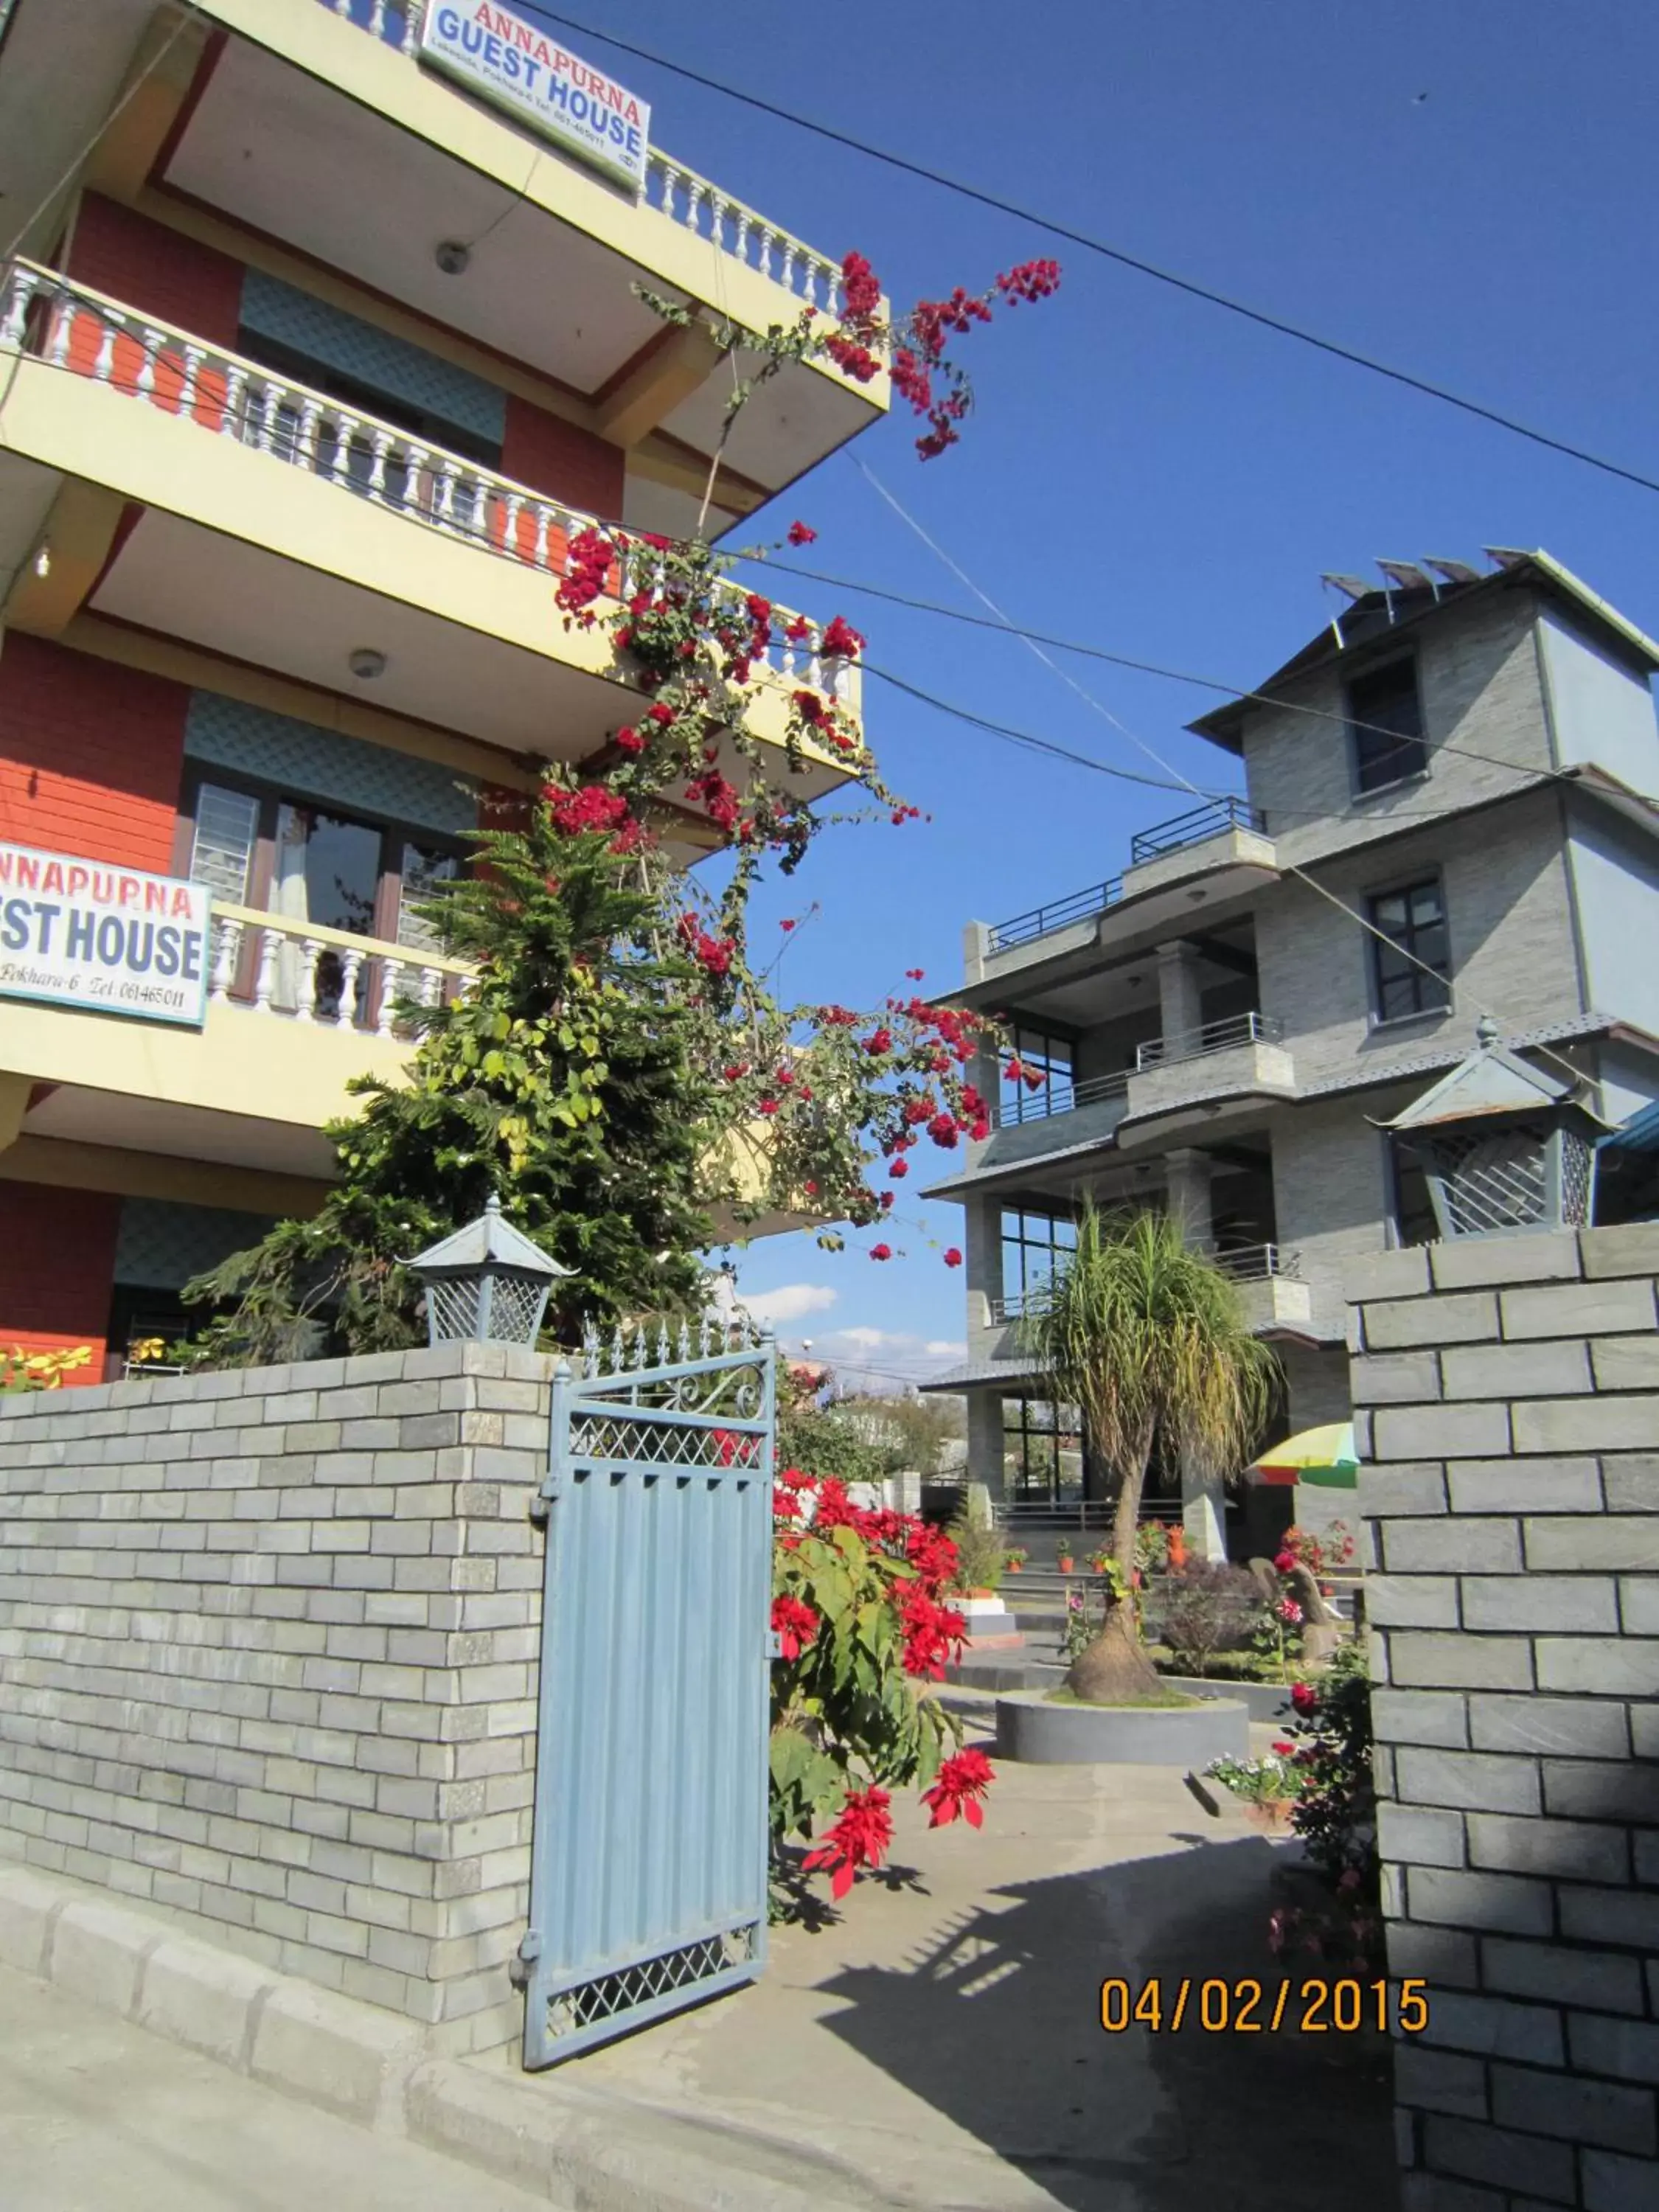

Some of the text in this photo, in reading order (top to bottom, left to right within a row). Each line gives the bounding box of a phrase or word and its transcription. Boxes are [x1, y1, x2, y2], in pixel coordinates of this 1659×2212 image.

[437, 8, 641, 158] GUEST HOUSE
[474, 1, 641, 127] ANNAPURNA
[0, 896, 202, 981] ST HOUSE
